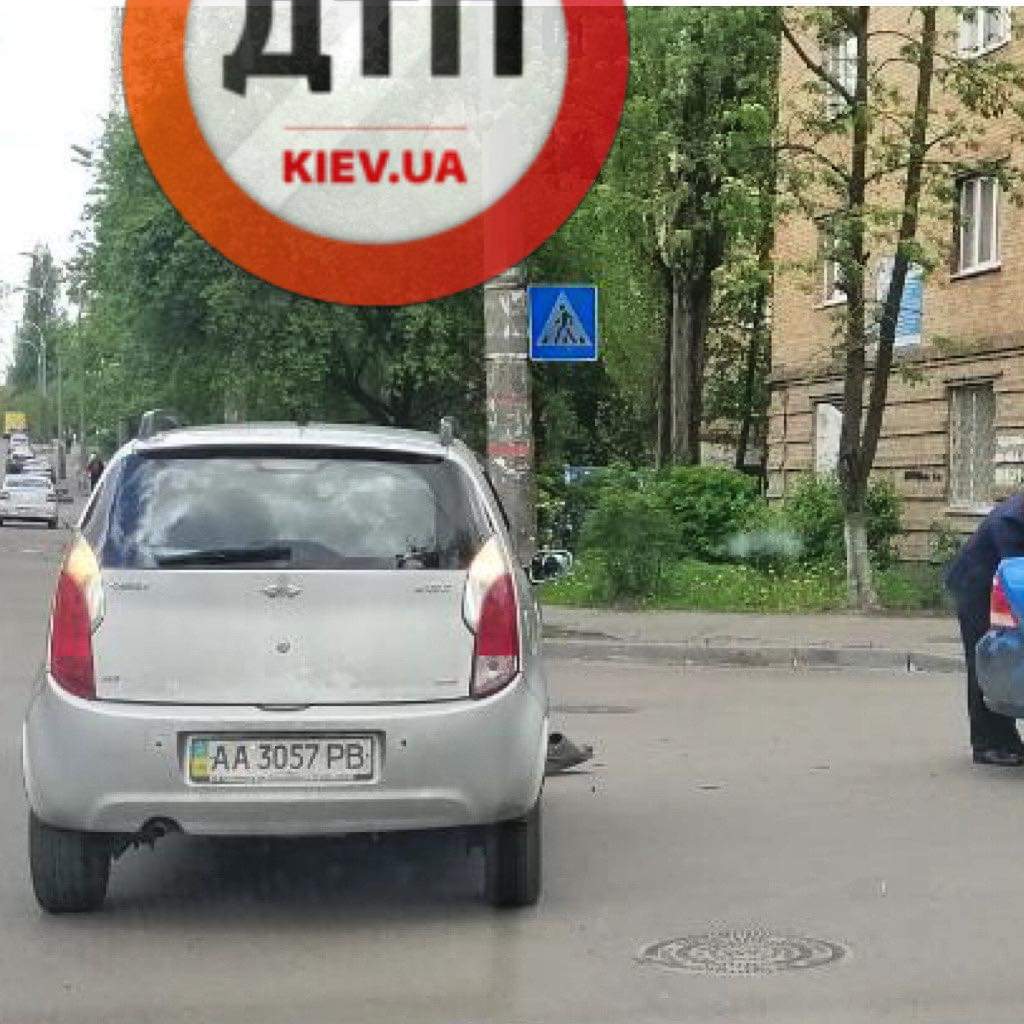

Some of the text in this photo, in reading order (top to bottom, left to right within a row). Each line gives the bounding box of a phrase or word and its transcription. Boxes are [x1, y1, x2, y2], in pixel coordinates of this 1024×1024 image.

[213, 743, 364, 770] AA 3057 PB
